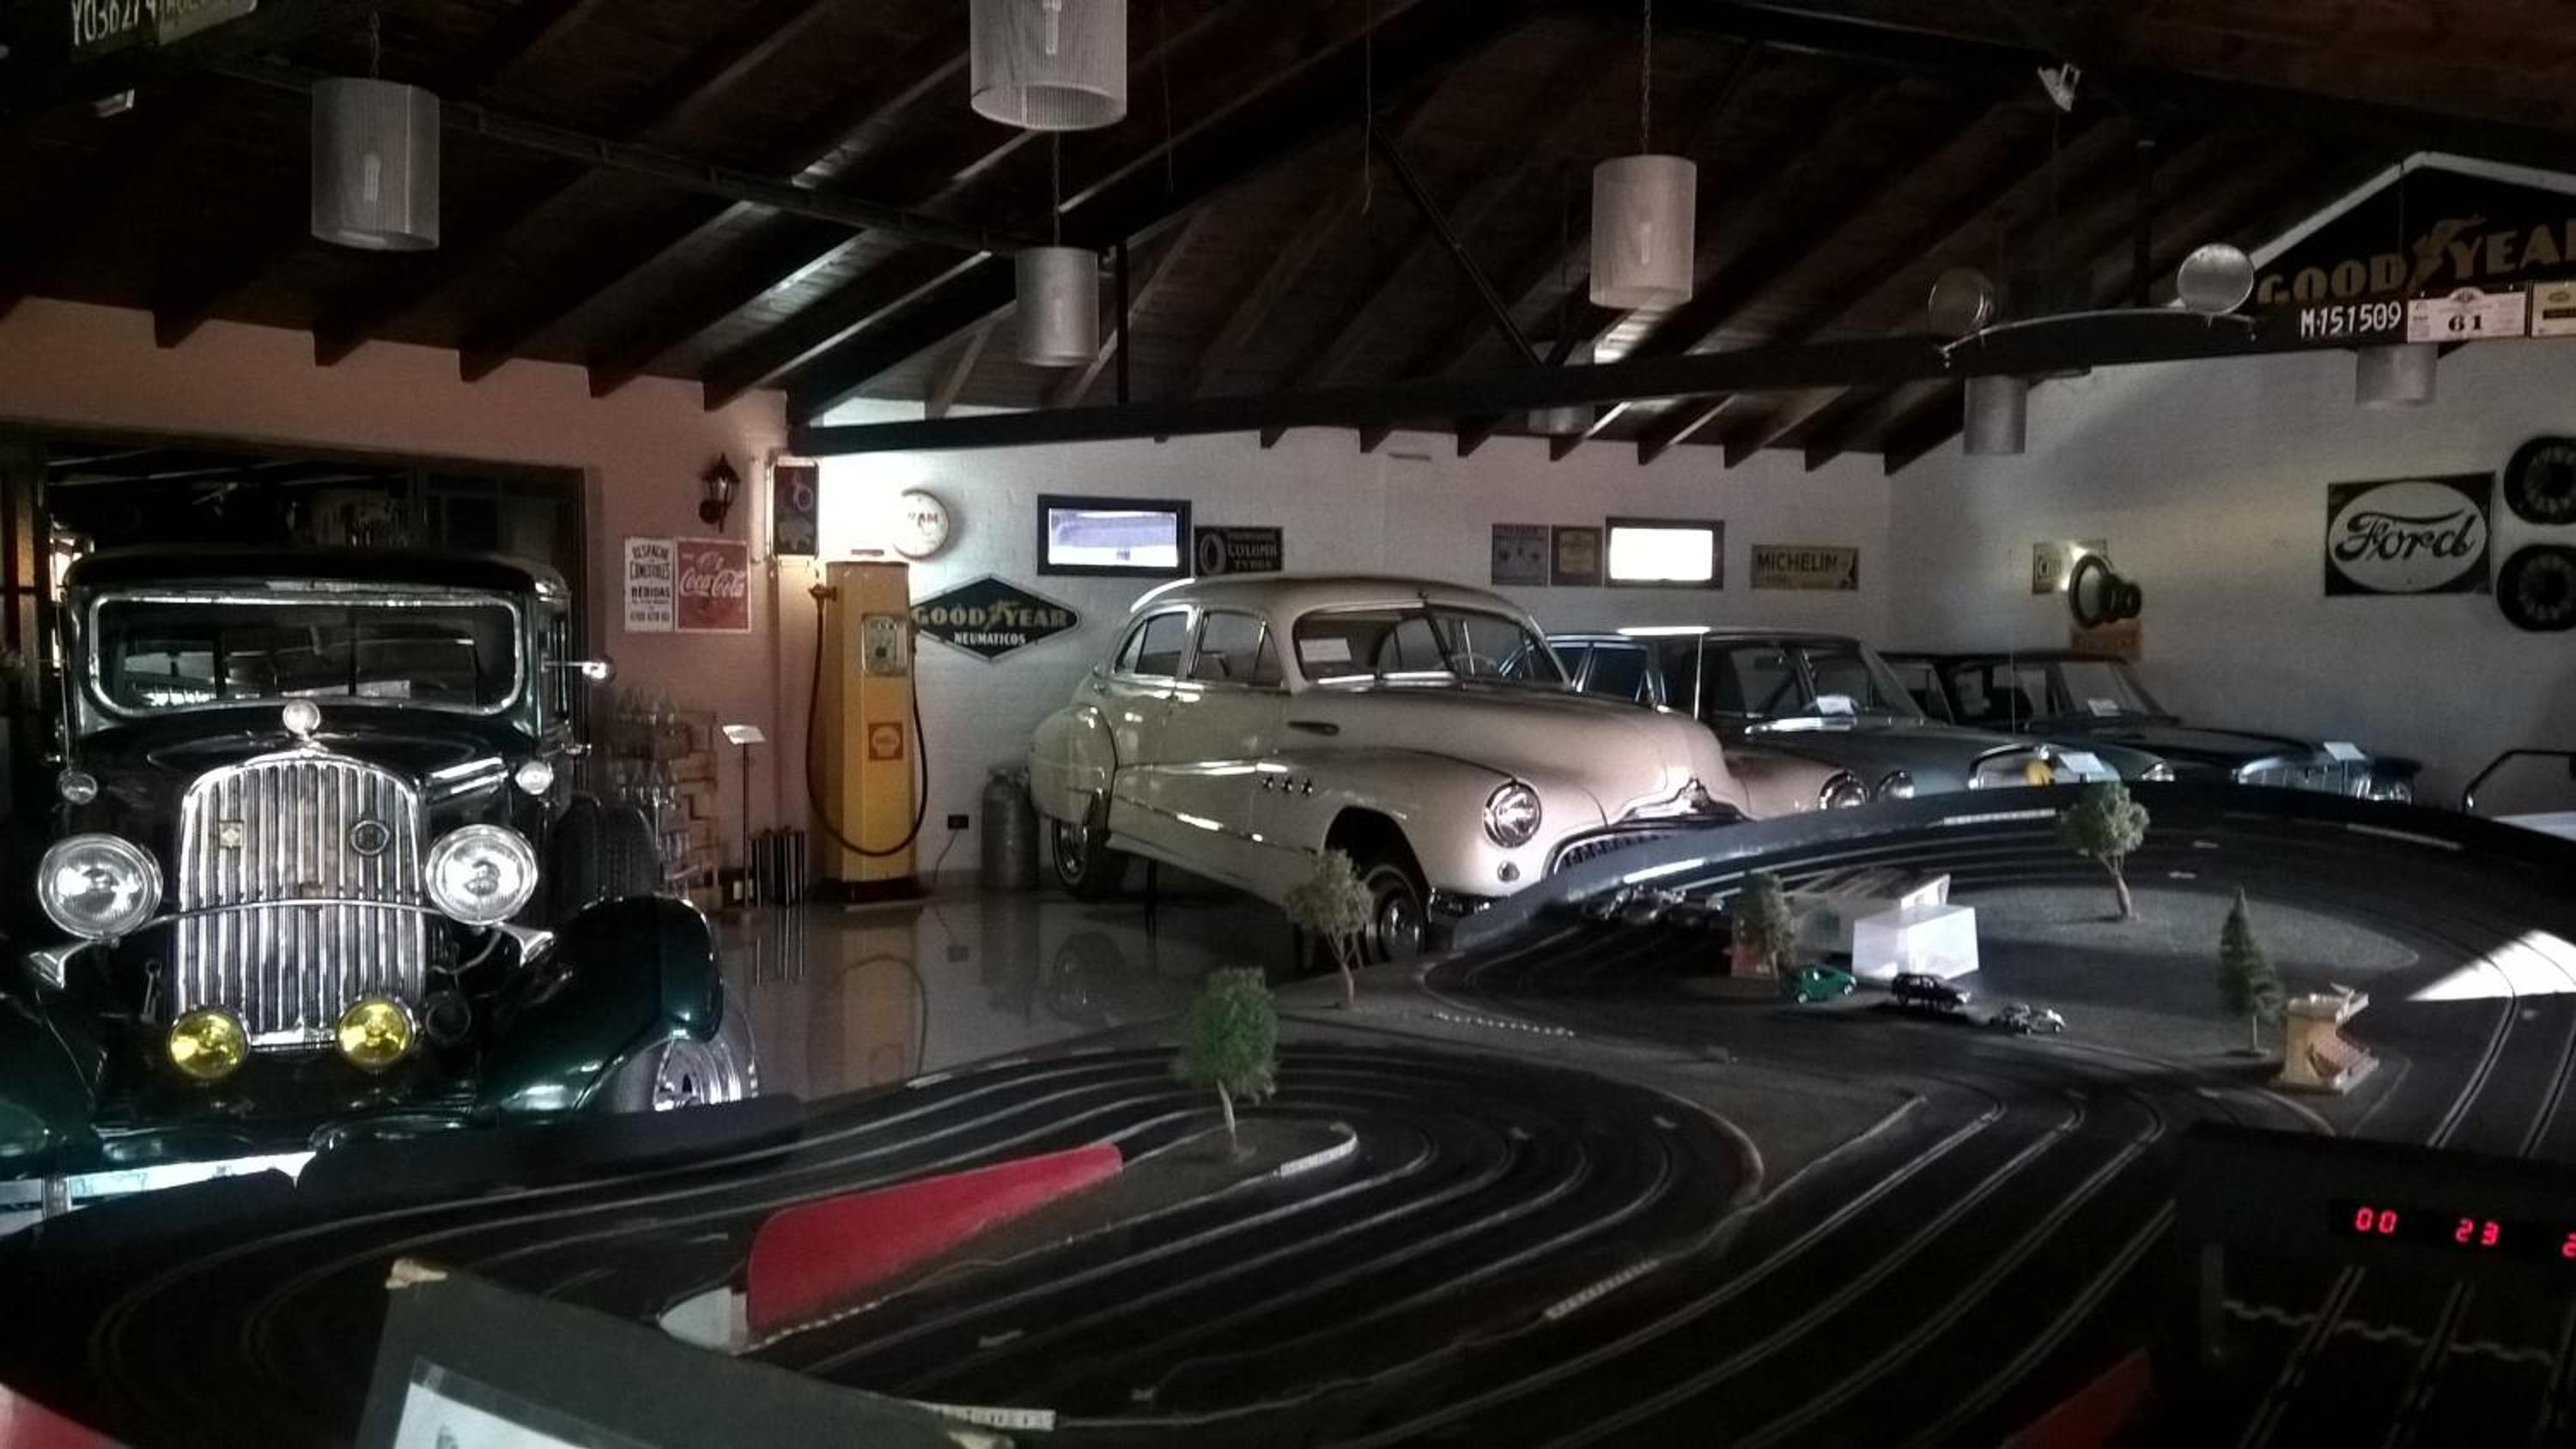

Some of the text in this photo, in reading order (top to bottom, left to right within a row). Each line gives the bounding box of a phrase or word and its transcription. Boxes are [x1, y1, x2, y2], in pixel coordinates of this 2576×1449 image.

[2445, 216, 2576, 280] YEA
[2448, 314, 2482, 332] 61
[2335, 508, 2477, 561] Ford
[1758, 552, 1838, 573] MICHELIN
[954, 632, 1026, 646] NEUMATICOS
[2353, 1204, 2401, 1236] 00
[2453, 1217, 2501, 1246] 23
